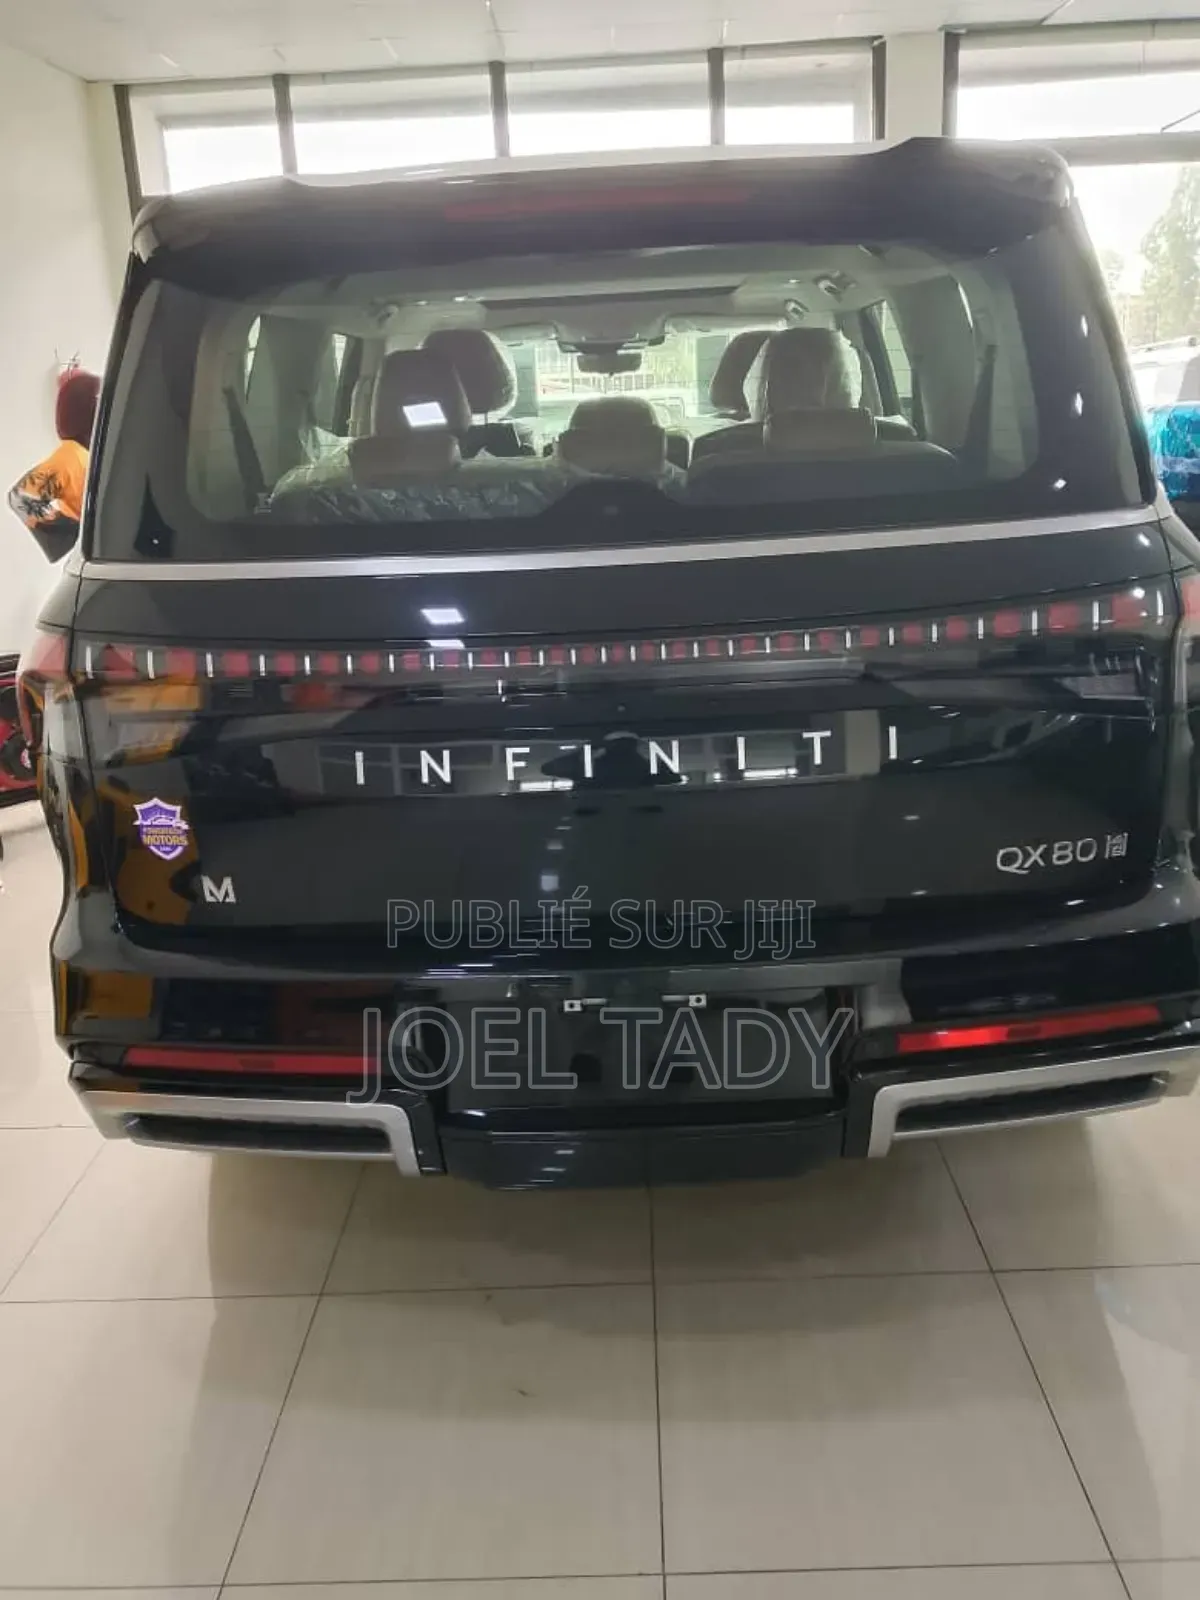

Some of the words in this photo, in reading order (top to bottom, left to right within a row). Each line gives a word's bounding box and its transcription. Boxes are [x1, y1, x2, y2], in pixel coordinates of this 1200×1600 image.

[355, 725, 898, 786] INFINITI
[142, 834, 189, 846] MOTORS
[996, 837, 1098, 875] QX80
